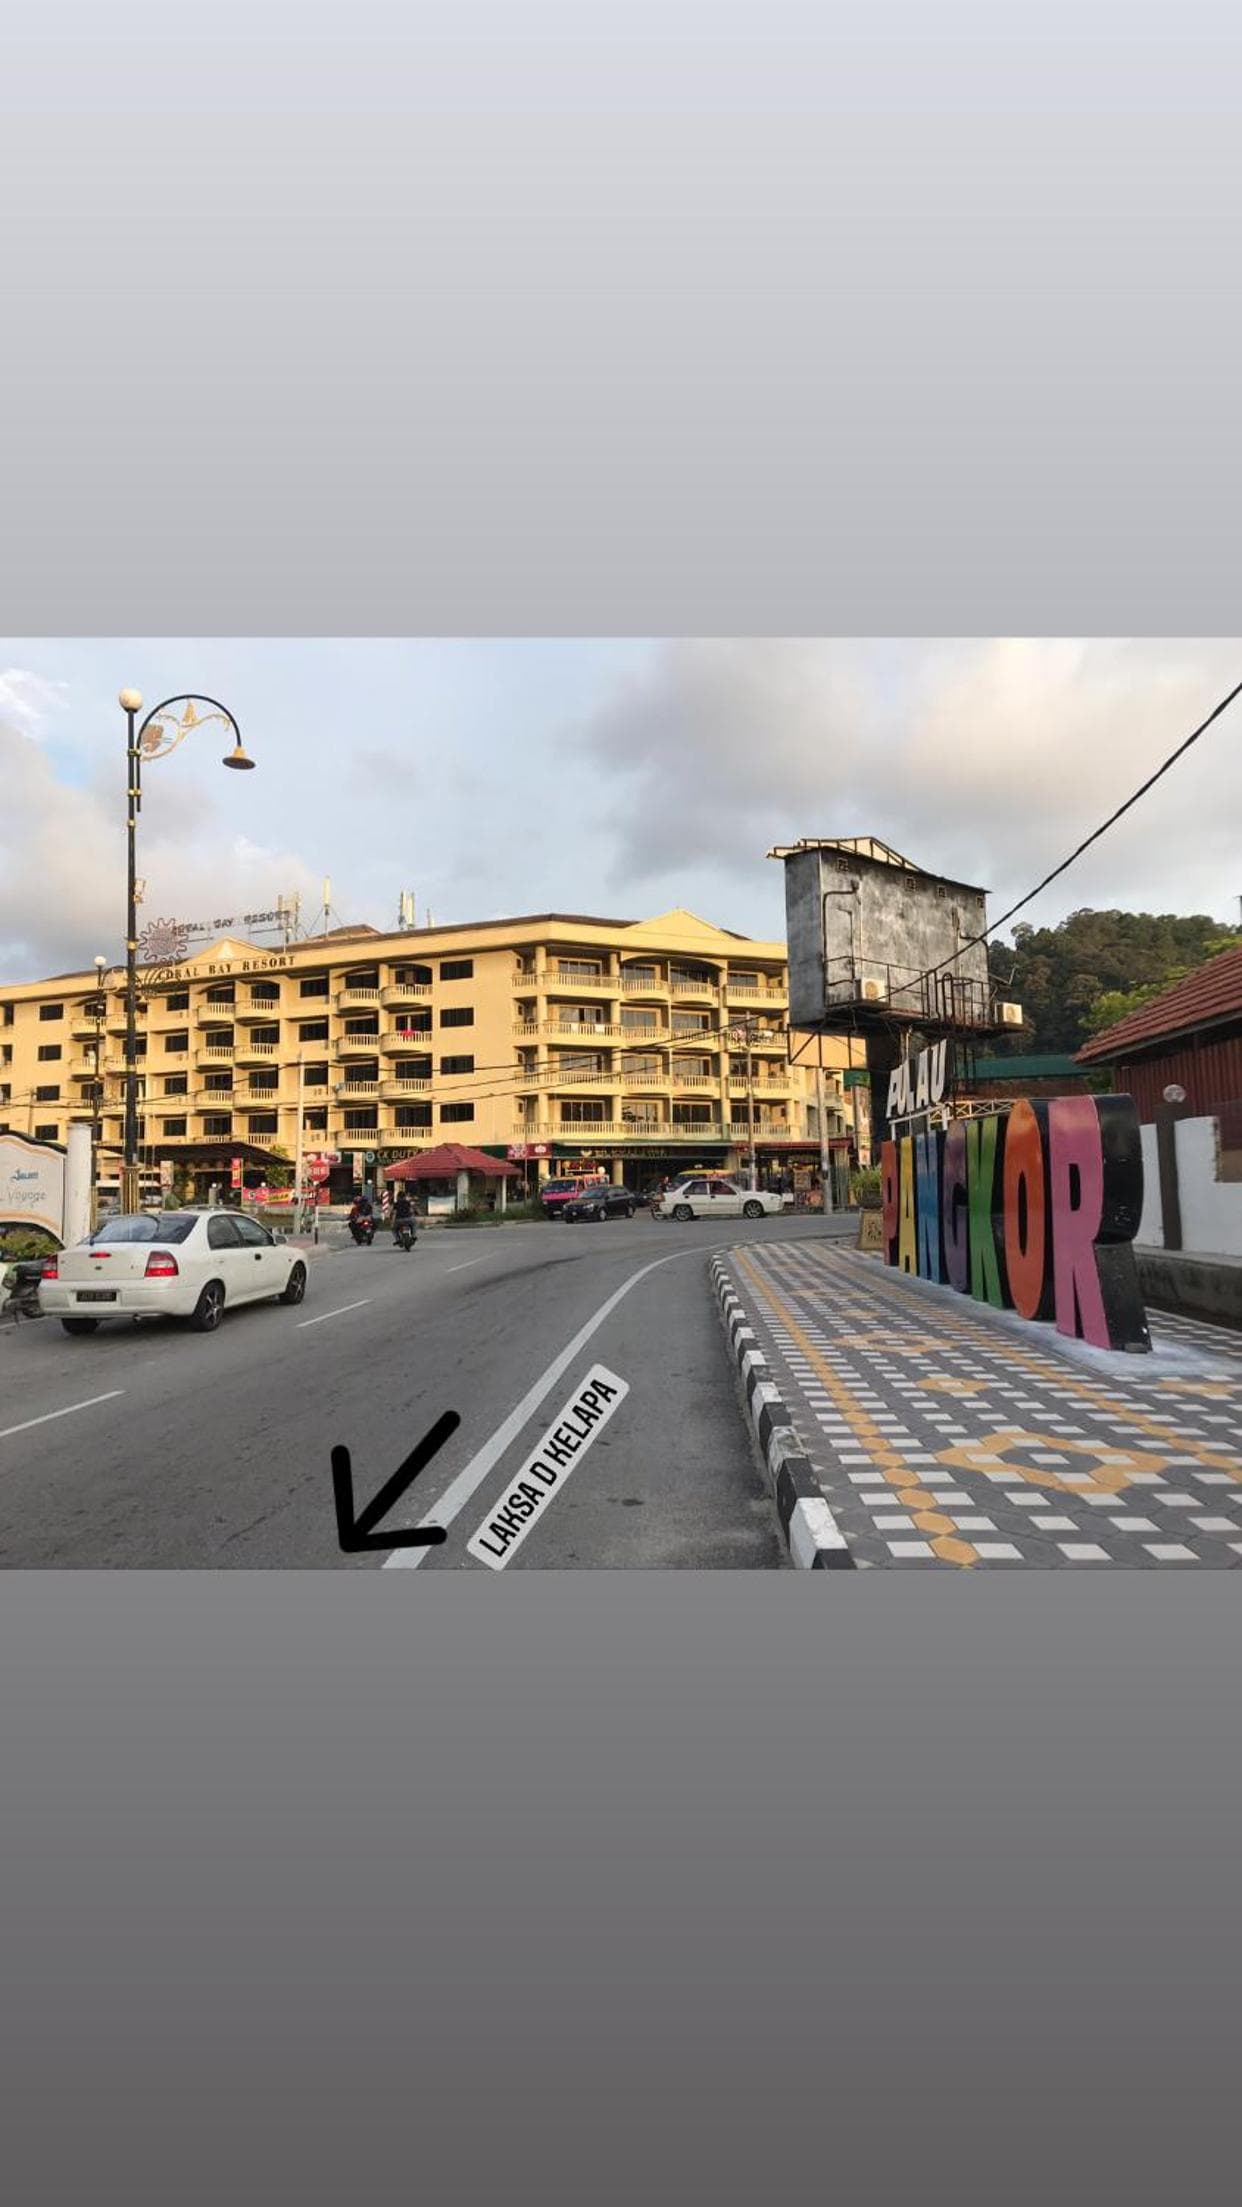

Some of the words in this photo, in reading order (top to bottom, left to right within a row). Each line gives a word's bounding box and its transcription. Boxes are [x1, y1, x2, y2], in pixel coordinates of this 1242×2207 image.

[208, 962, 232, 975] BAY
[242, 956, 295, 972] RESORT
[886, 1038, 948, 1118] PULAU
[880, 1094, 1130, 1351] PANGKOR
